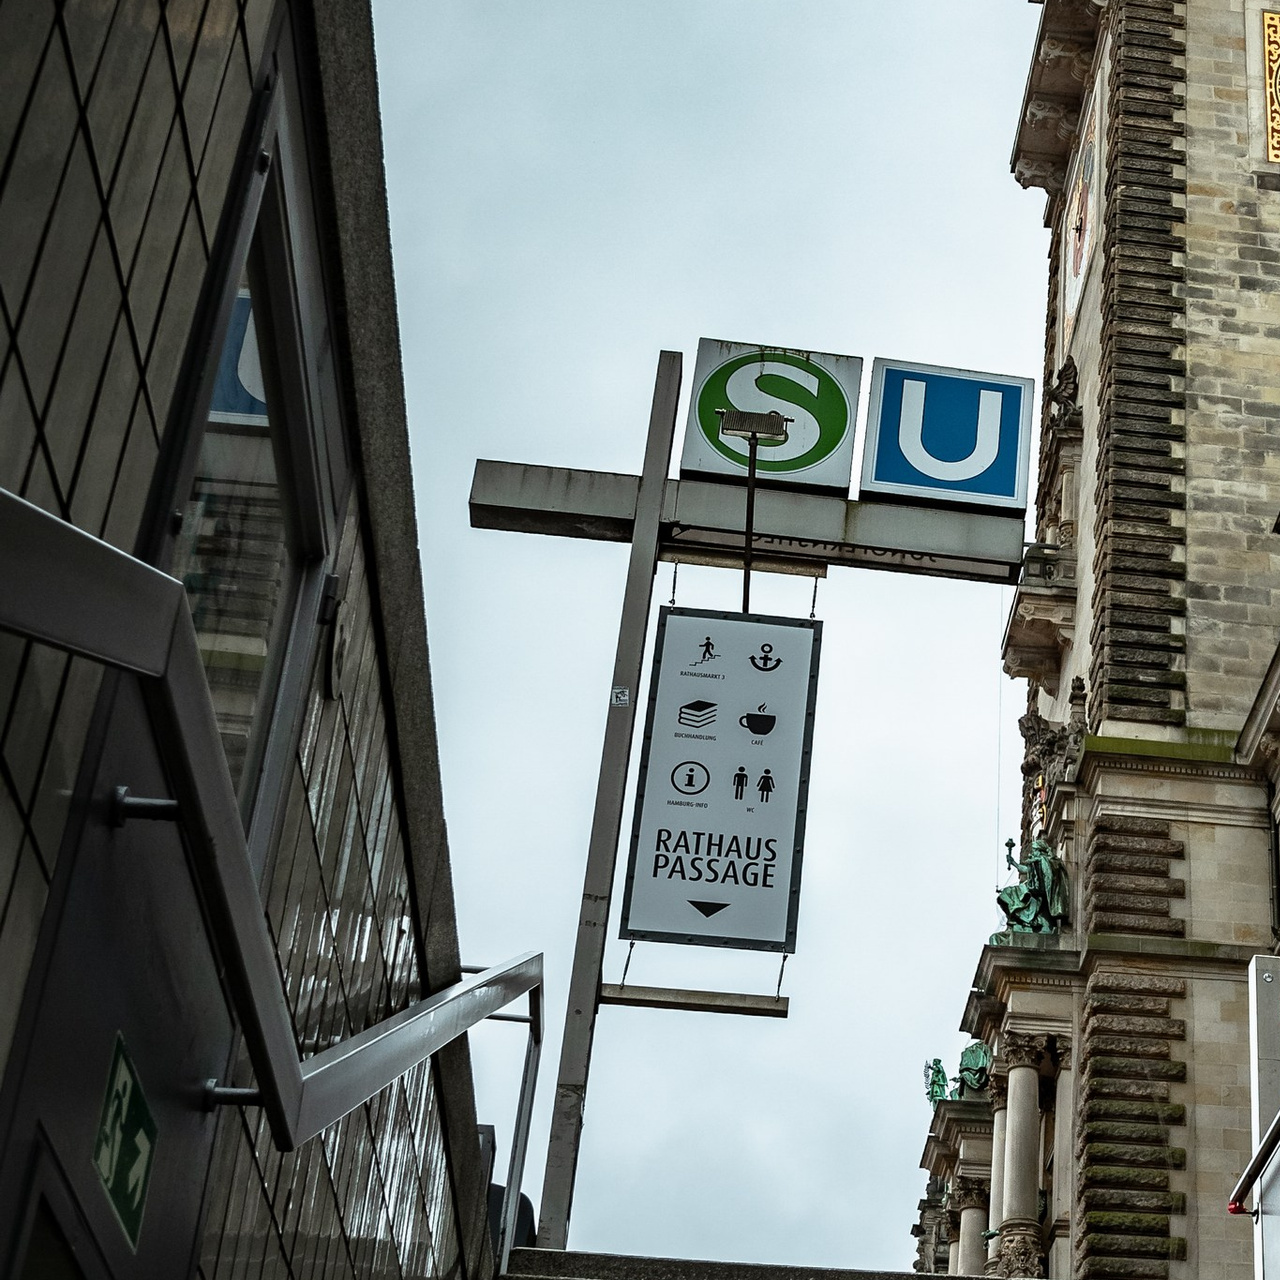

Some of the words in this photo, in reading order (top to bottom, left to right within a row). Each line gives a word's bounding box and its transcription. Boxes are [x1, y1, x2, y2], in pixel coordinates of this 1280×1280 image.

[718, 361, 821, 462] S
[898, 378, 1003, 482] U
[680, 670, 721, 680] RATHAUSMARKT
[674, 732, 717, 741] BUCHHANDLUNG
[667, 800, 708, 809] HAMBURG-INFO
[655, 828, 778, 862] RATHAUS
[652, 853, 776, 888] PASSAGE
